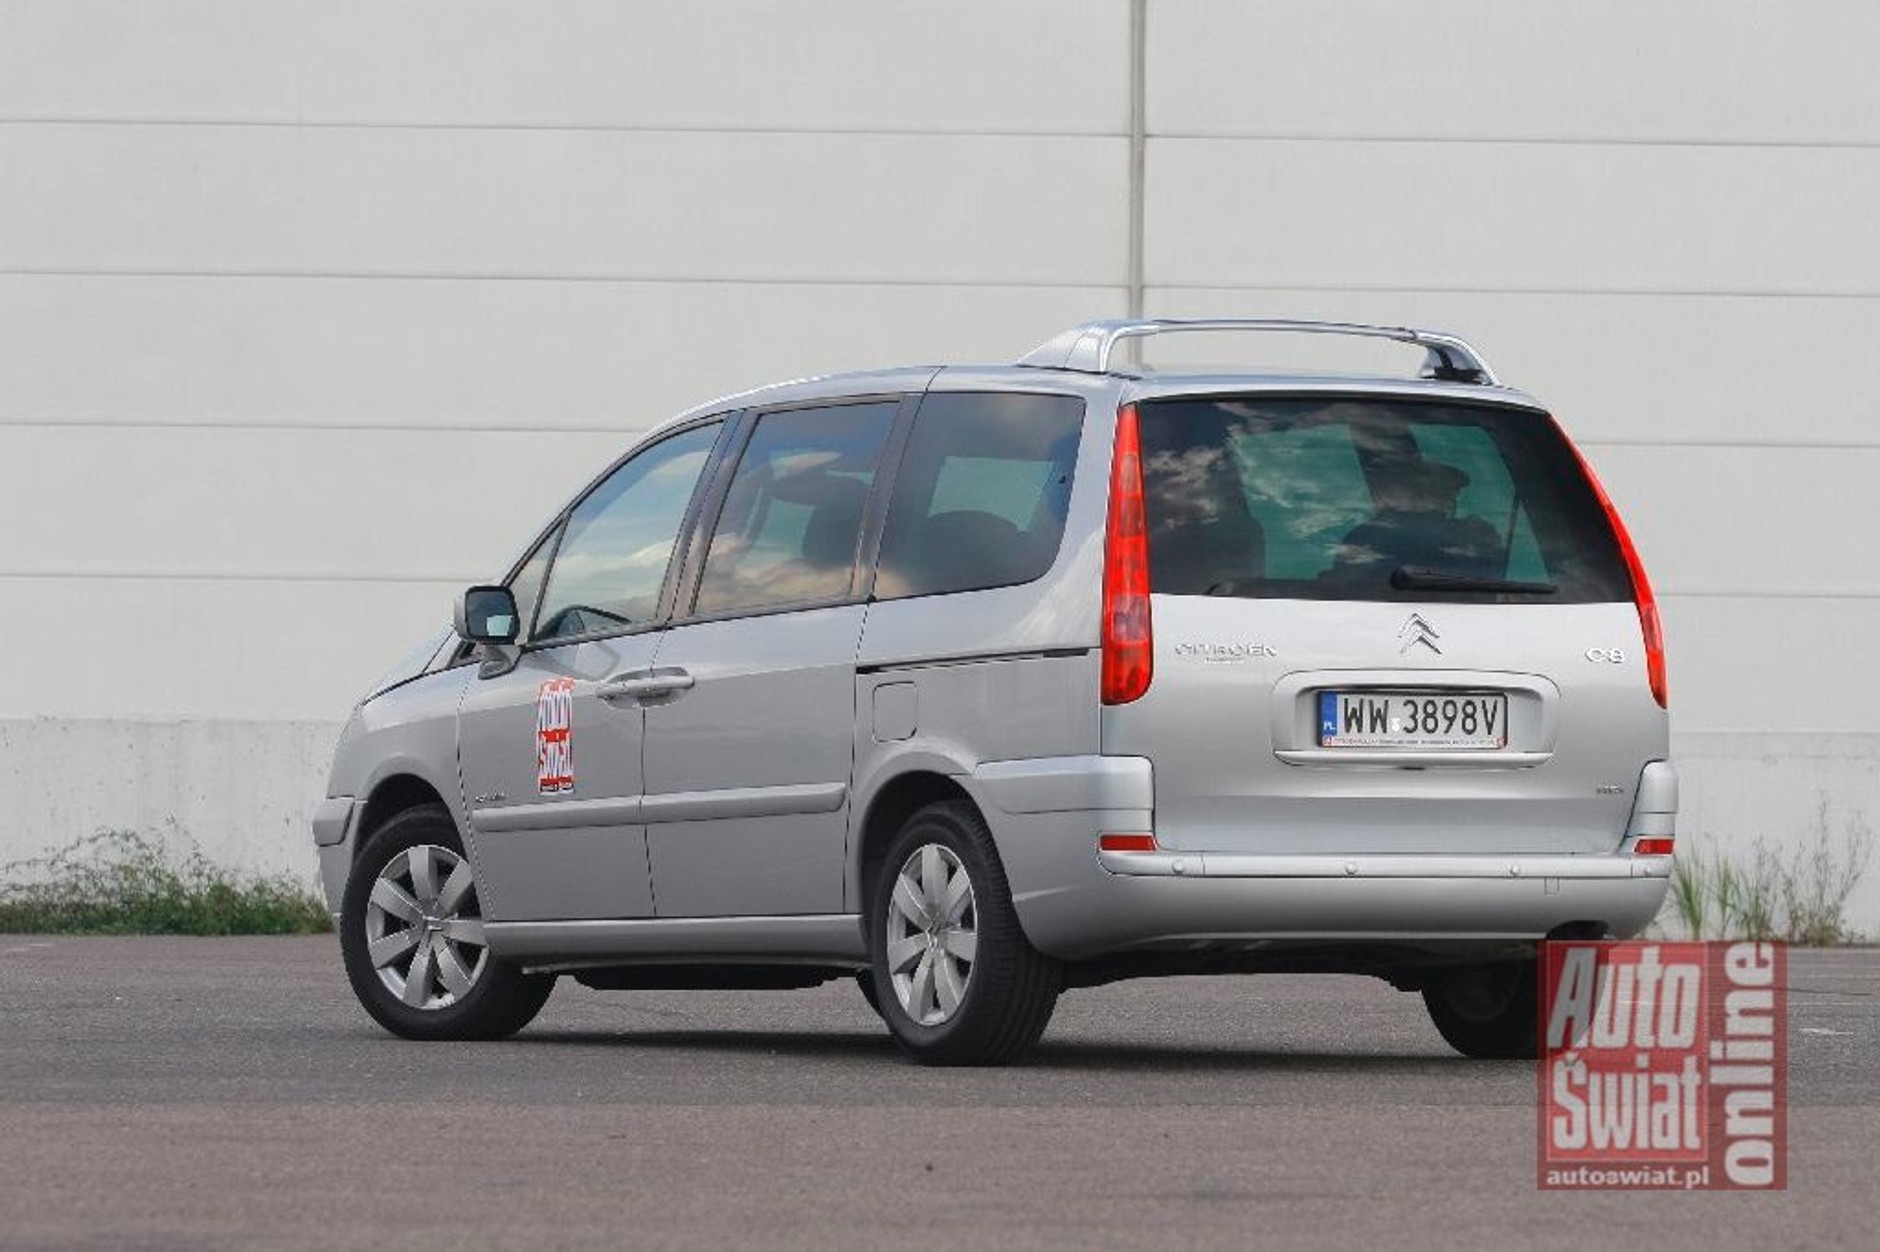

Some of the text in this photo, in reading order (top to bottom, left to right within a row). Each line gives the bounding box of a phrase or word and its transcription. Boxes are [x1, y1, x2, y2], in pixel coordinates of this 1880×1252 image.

[1584, 648, 1625, 664] C8
[1343, 697, 1498, 735] WW 3898V
